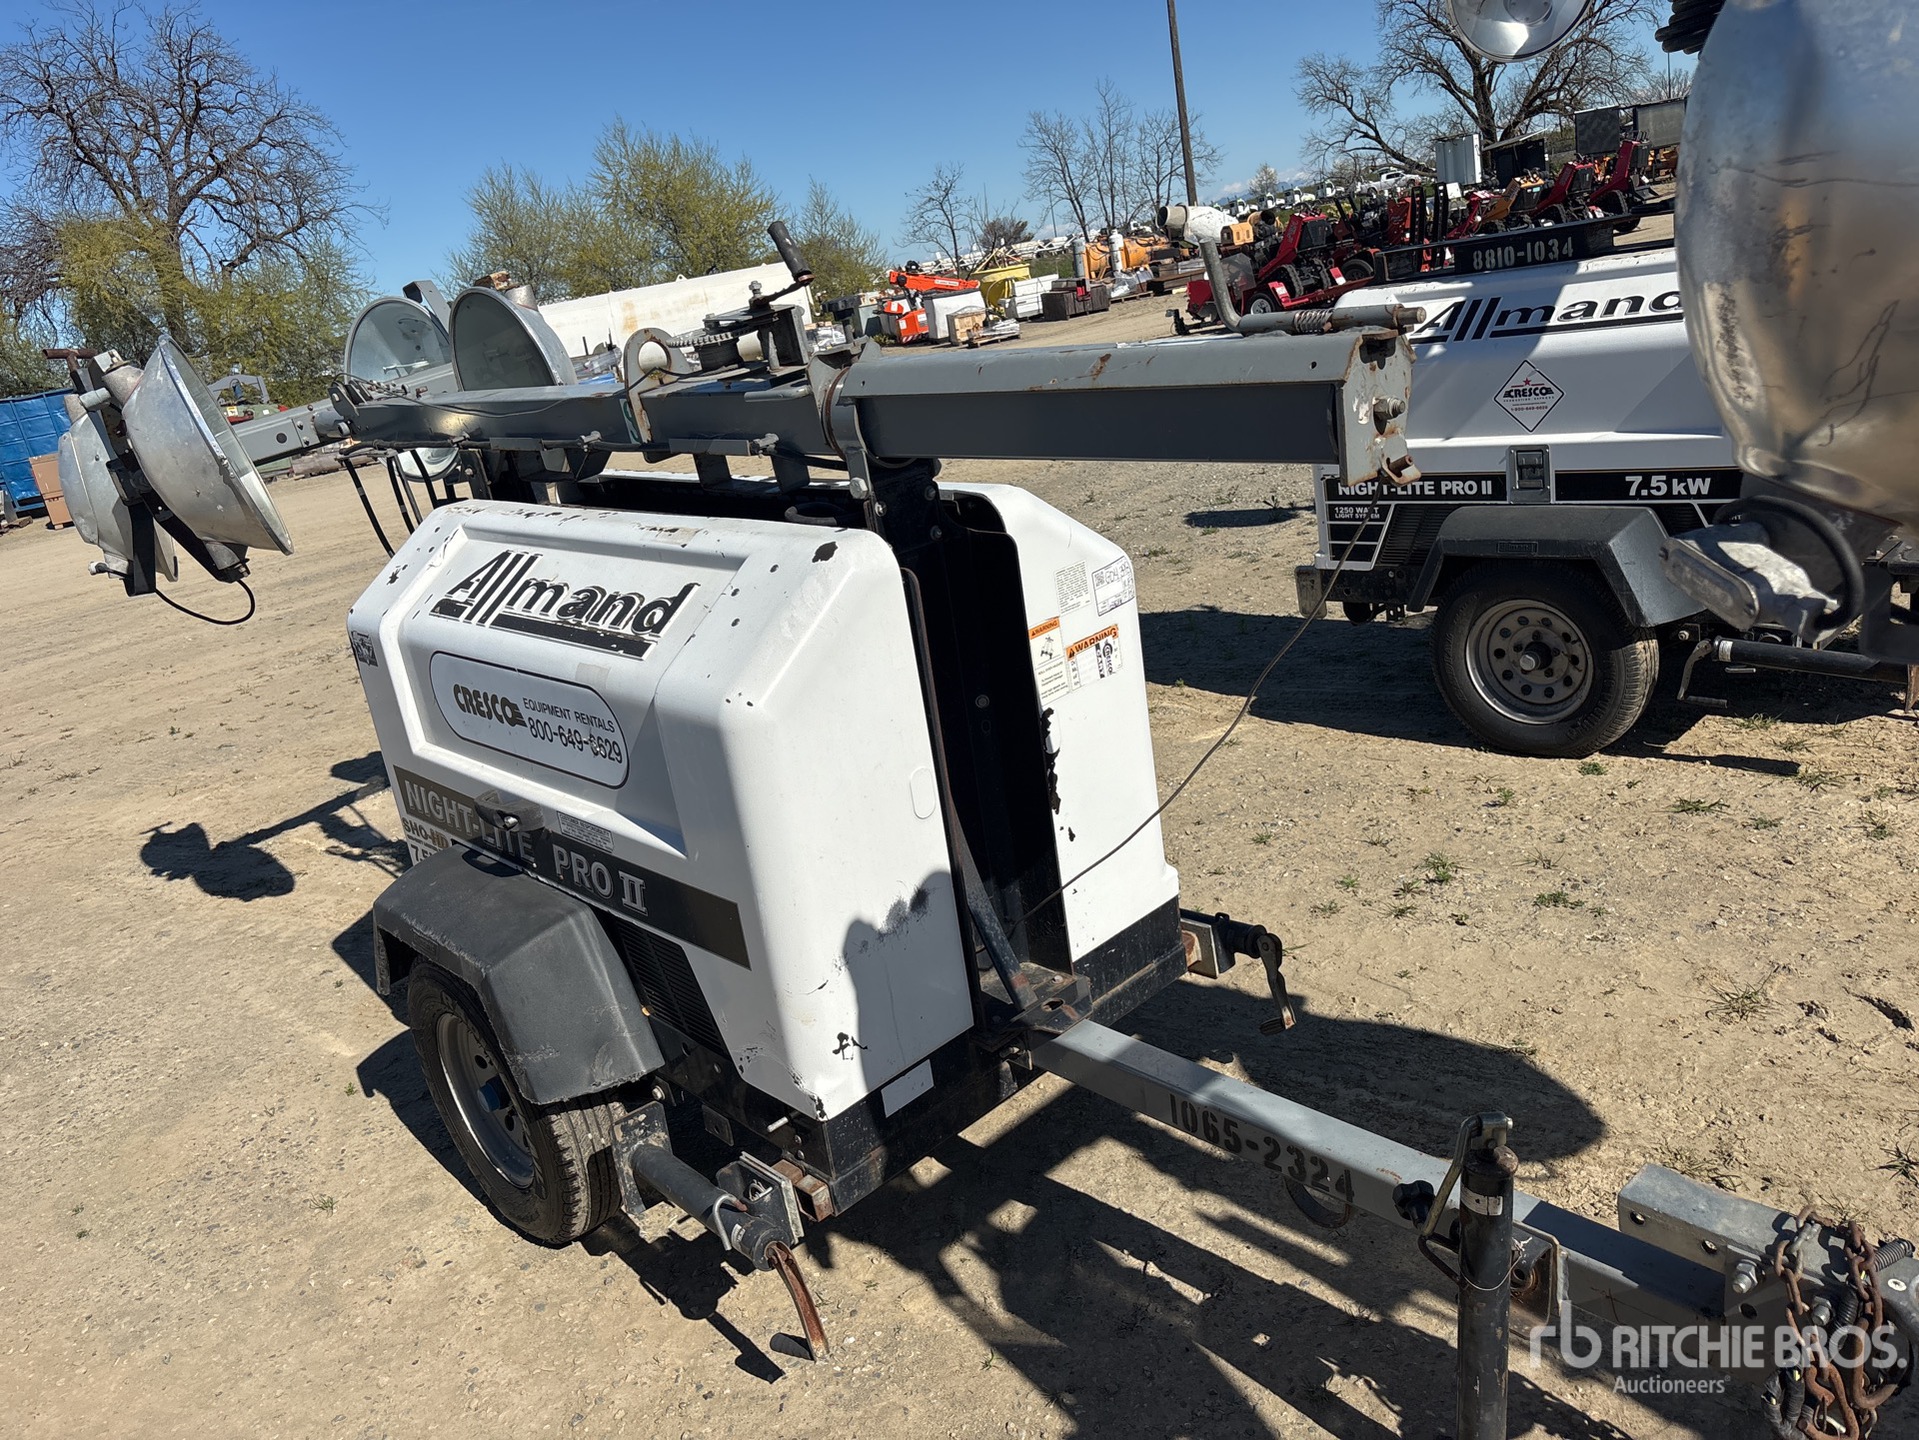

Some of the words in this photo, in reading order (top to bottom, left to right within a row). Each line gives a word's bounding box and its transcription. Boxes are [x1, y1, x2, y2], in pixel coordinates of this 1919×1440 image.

[1473, 236, 1574, 271] 8810-1034
[1503, 386, 1554, 399] CRESCO
[1338, 480, 1435, 496] NIGHT-LITE
[1441, 480, 1478, 496] PRO
[1481, 480, 1493, 495] II
[1625, 475, 1668, 496] 7.5
[1672, 477, 1712, 495] kW
[436, 549, 701, 644] Allmand
[1034, 619, 1058, 634] WARNING
[1075, 627, 1117, 653] WARNING
[452, 683, 527, 728] CRESCO
[522, 697, 571, 721] EQUIPMENT
[574, 711, 615, 733] RENTALS
[528, 717, 623, 764] 800-649-6629
[404, 779, 537, 864] NIGHT-LITE
[552, 844, 615, 899] PRO
[618, 870, 649, 916] II
[1168, 1093, 1356, 1204] 1065-2324
